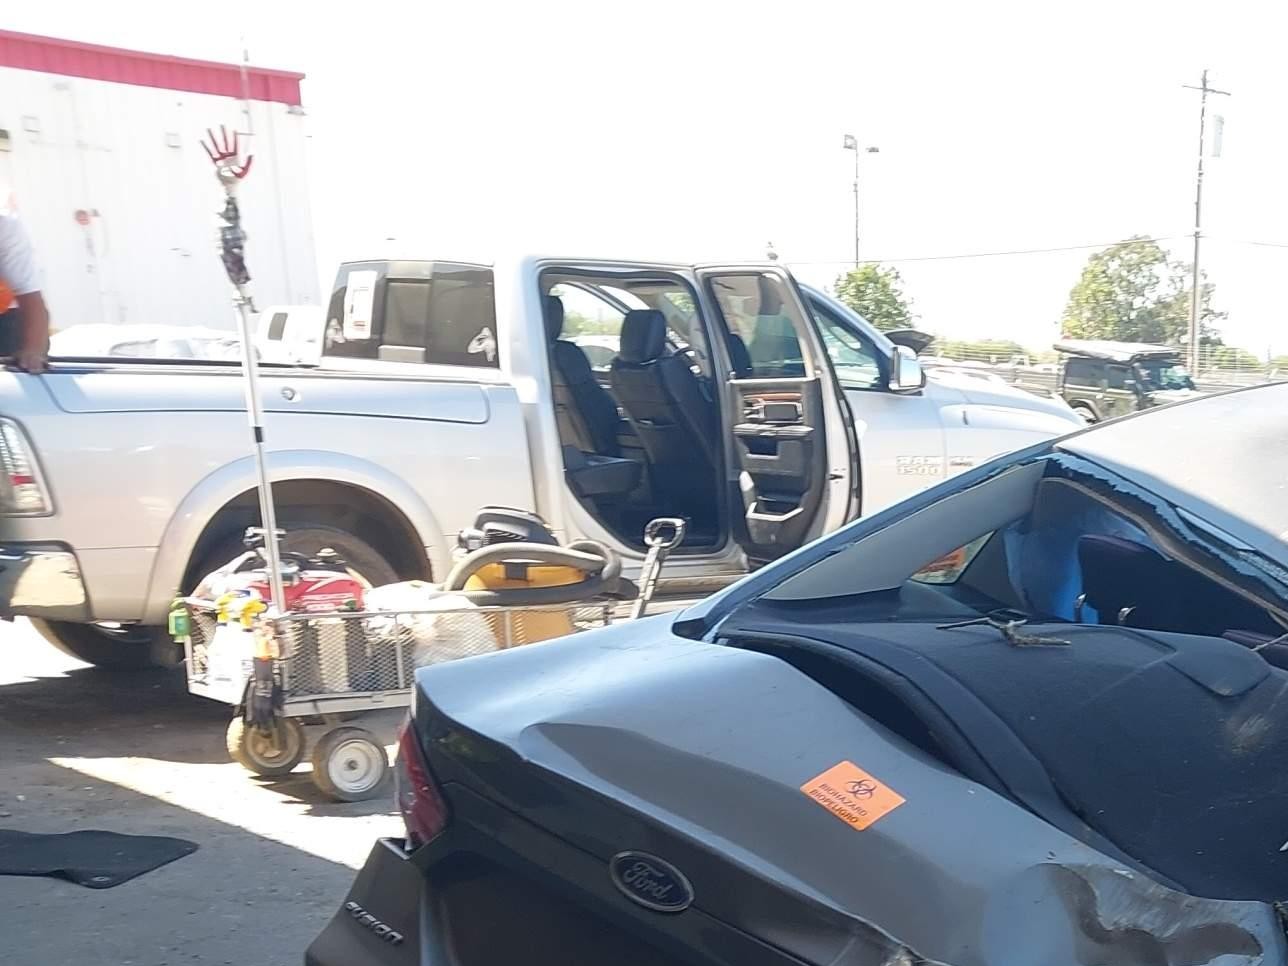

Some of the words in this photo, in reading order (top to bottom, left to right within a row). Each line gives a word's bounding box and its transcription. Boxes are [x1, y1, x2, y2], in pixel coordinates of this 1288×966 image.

[809, 788, 859, 823] BIOPELIGRO
[818, 783, 868, 817] BIOHAZARD
[623, 862, 674, 899] Ford
